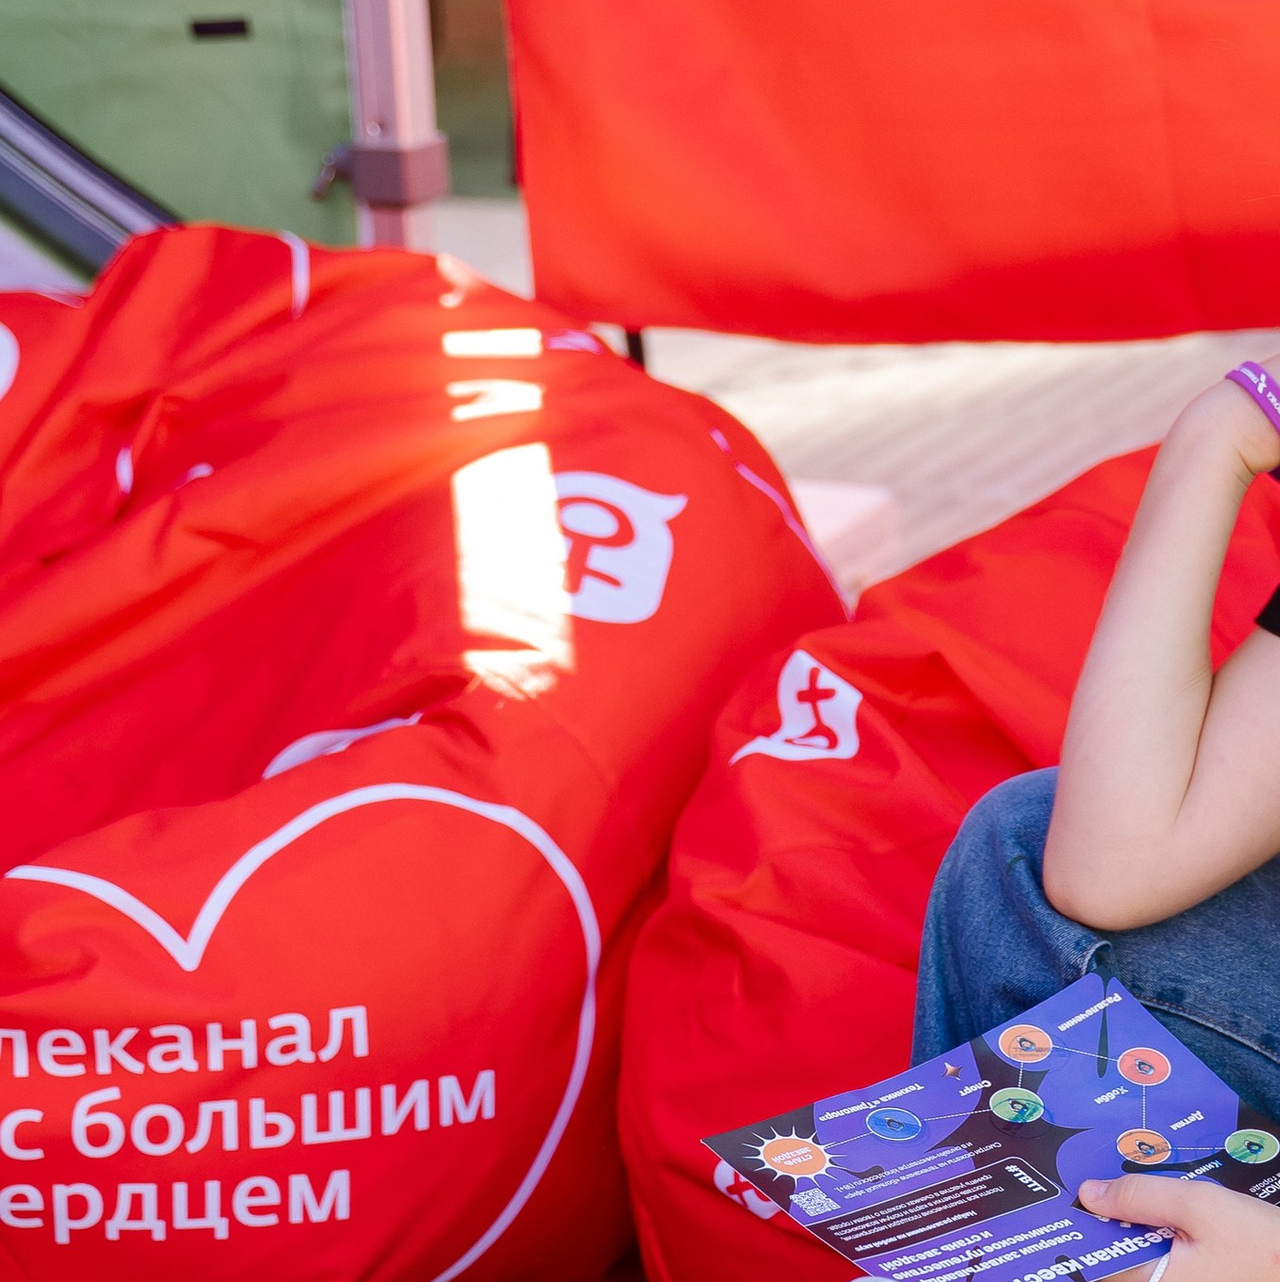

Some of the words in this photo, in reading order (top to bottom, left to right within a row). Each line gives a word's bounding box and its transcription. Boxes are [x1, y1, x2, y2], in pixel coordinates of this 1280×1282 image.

[1057, 992, 1121, 1031] Развлечения
[878, 1081, 924, 1102] Техника
[957, 1078, 991, 1096] Спорт
[1093, 1085, 1128, 1105] Хобби
[0, 1108, 44, 1161] с
[71, 1070, 496, 1159] большим
[817, 1097, 879, 1123] «Триколор»
[1169, 1109, 1204, 1130] Детям
[770, 1146, 811, 1163] ЗВЕЗДОЙ
[782, 1153, 812, 1166] СТАНЬ
[1194, 1158, 1222, 1175] Кино
[1248, 1174, 1277, 1193] городе
[948, 1209, 976, 1222] Найди
[905, 1216, 952, 1236] развлечения
[981, 1218, 1073, 1252] космическое
[853, 1241, 873, 1251] вкус
[871, 1235, 896, 1248] любой
[939, 1233, 981, 1252] стань
[1017, 1230, 1083, 1257] Соверши
[1078, 1224, 1175, 1267] вездная
[878, 1245, 940, 1272] звездой!
[892, 1244, 982, 1280] путешествие
